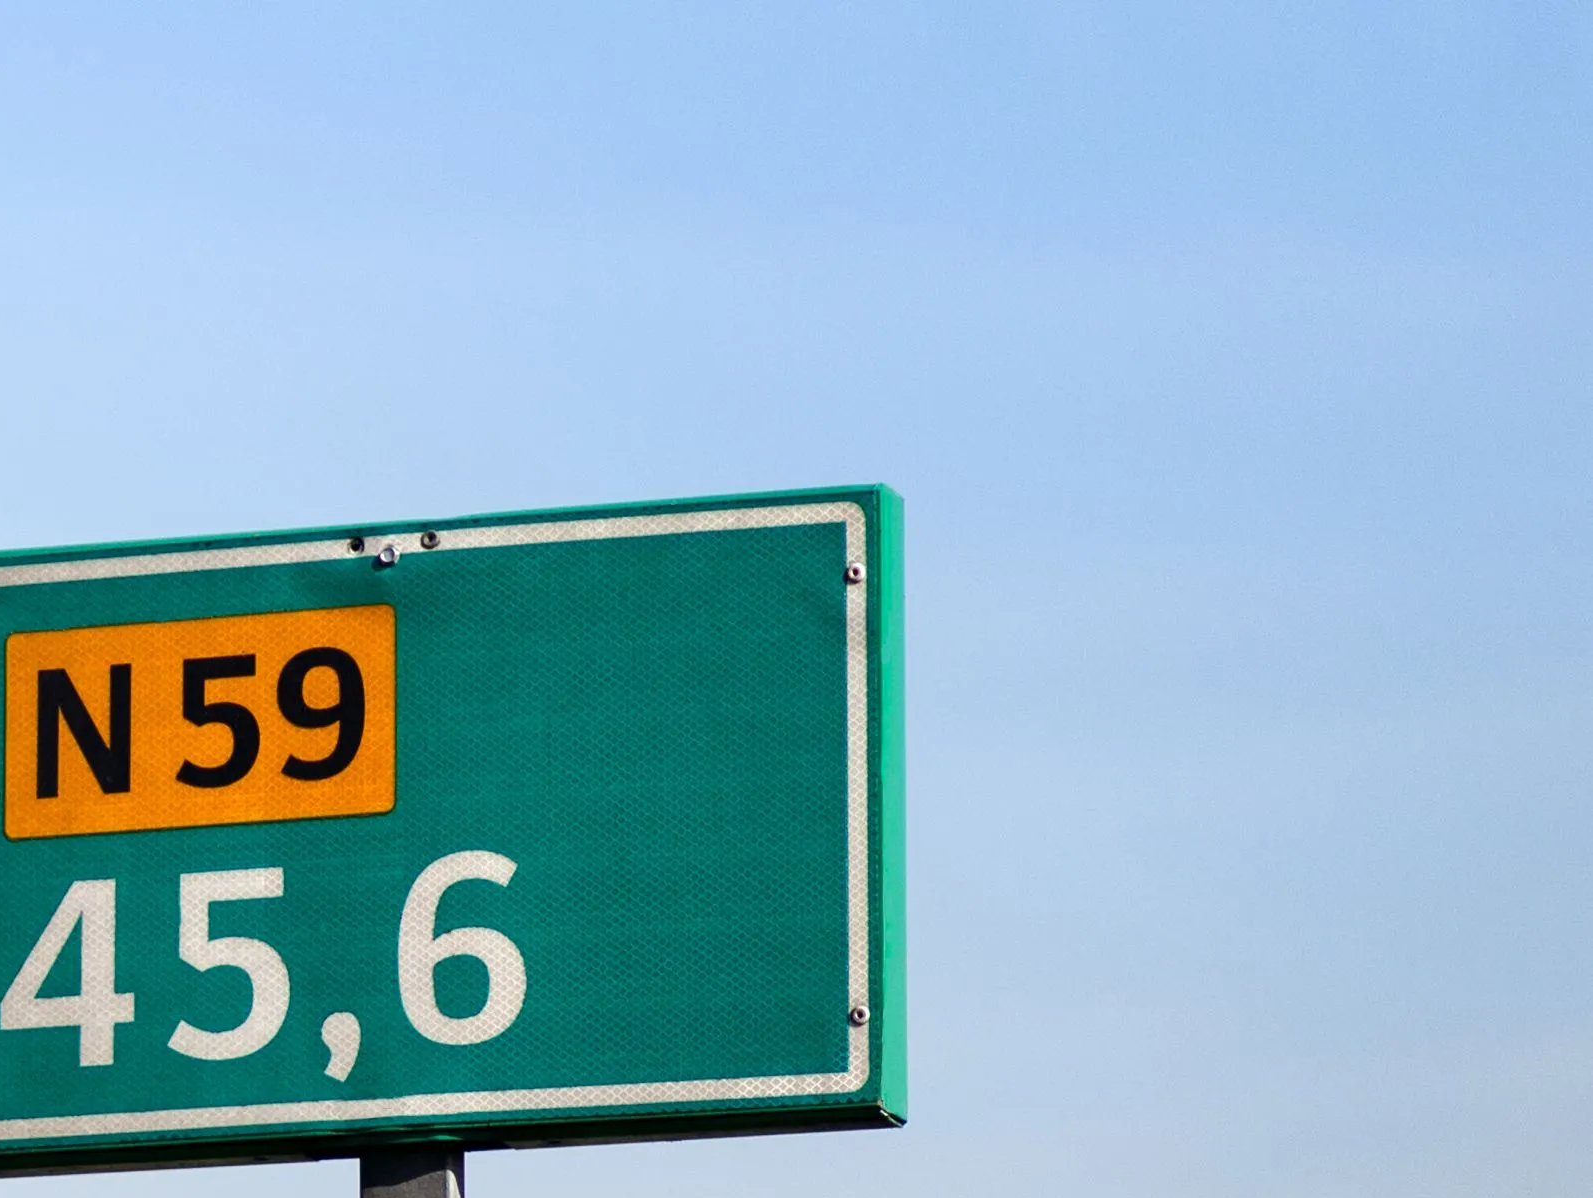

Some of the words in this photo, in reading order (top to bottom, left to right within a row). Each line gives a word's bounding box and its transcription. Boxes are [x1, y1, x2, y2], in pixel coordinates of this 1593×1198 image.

[36, 664, 132, 800] N
[176, 646, 366, 789] 59
[0, 850, 527, 1082] 45,6
